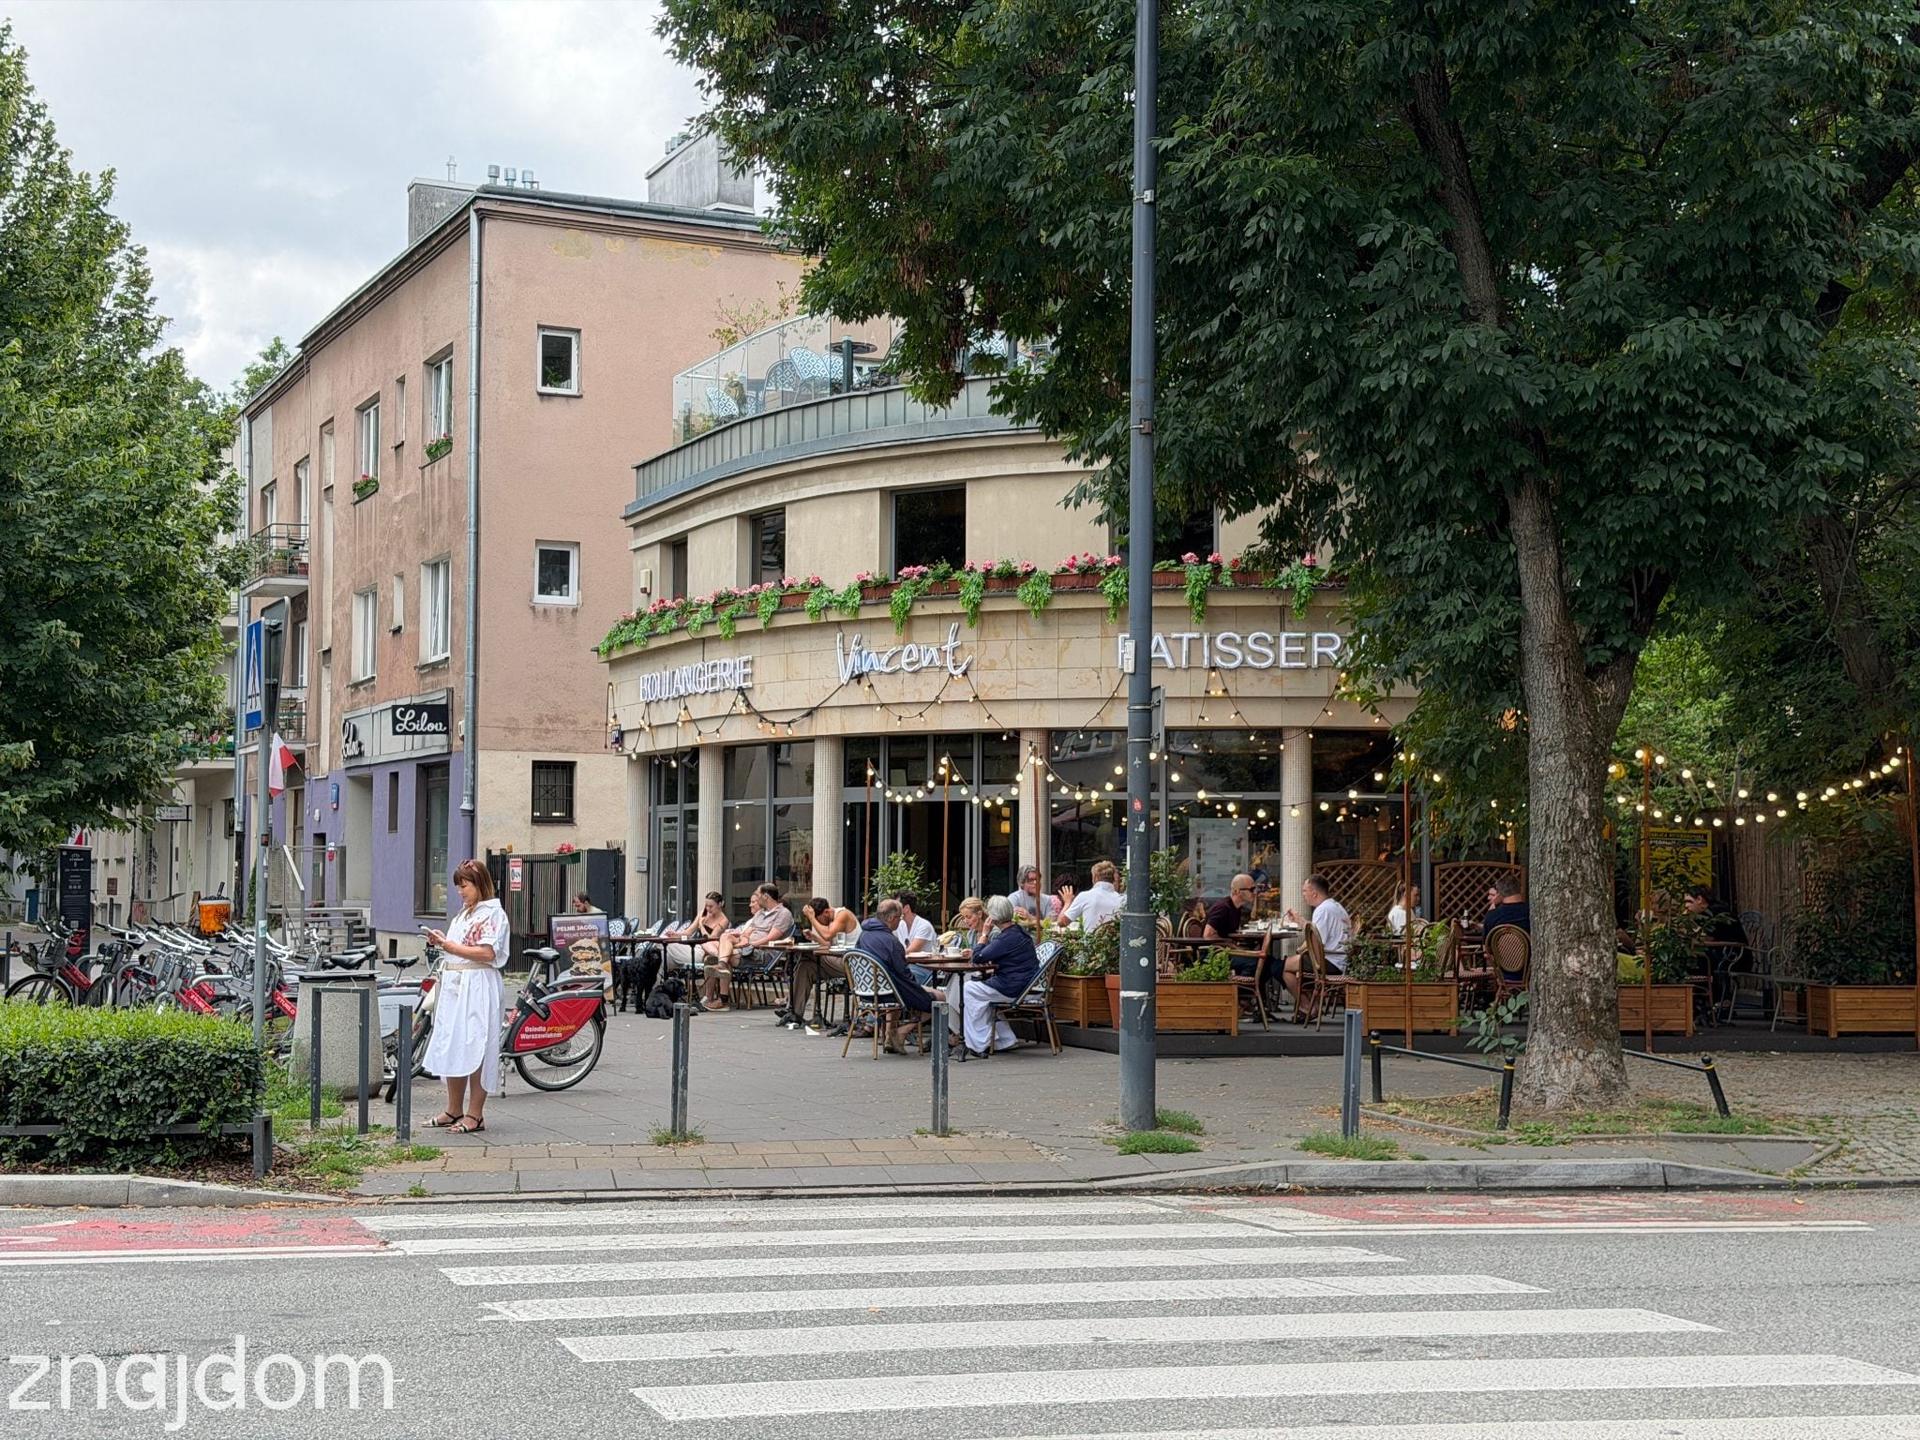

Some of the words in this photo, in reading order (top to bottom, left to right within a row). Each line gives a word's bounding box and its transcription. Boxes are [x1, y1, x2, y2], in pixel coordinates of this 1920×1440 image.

[836, 622, 973, 685] Vincent
[1118, 631, 1345, 669] ATISSER
[639, 655, 753, 702] BOULANGERIE
[395, 707, 448, 732] Lilou
